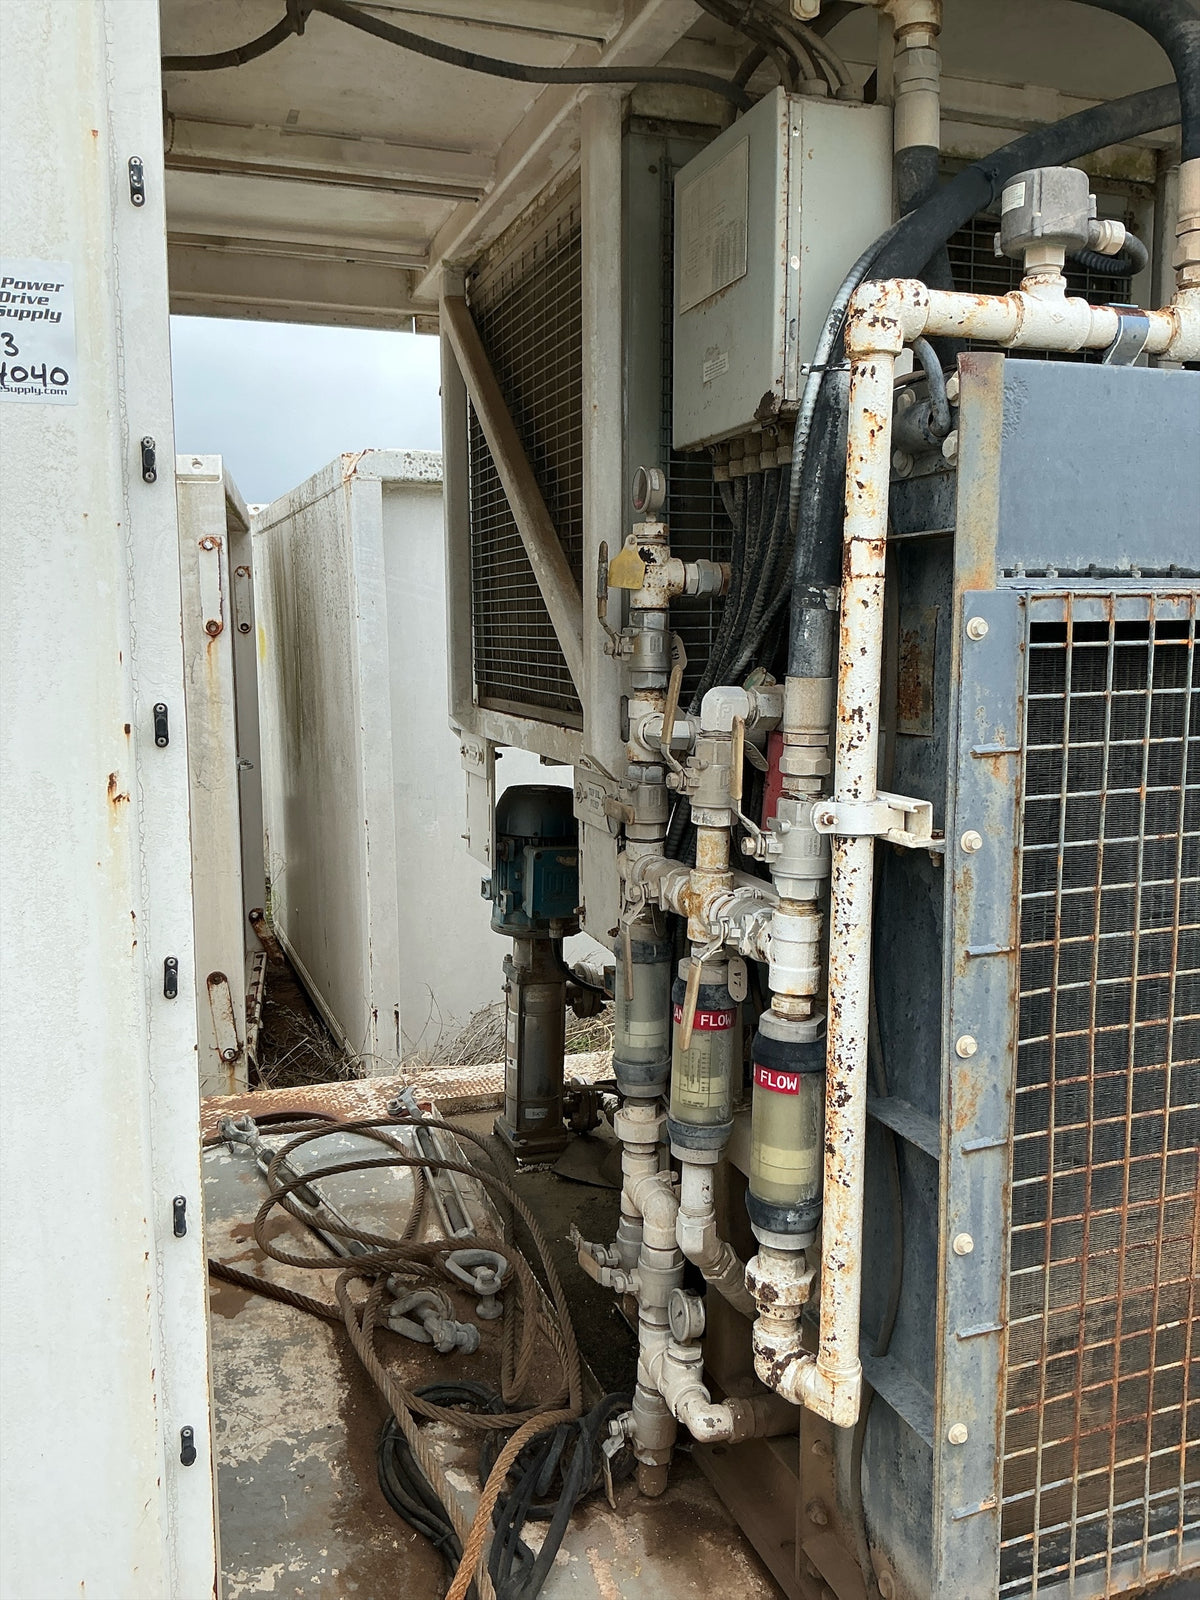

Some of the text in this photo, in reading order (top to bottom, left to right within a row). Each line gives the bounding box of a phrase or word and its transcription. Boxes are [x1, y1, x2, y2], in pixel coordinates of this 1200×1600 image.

[1, 277, 64, 292] Power
[0, 291, 49, 305] Drive
[1, 332, 19, 357] 3
[700, 1014, 732, 1027] FLOW
[760, 1070, 798, 1091] FLOW
